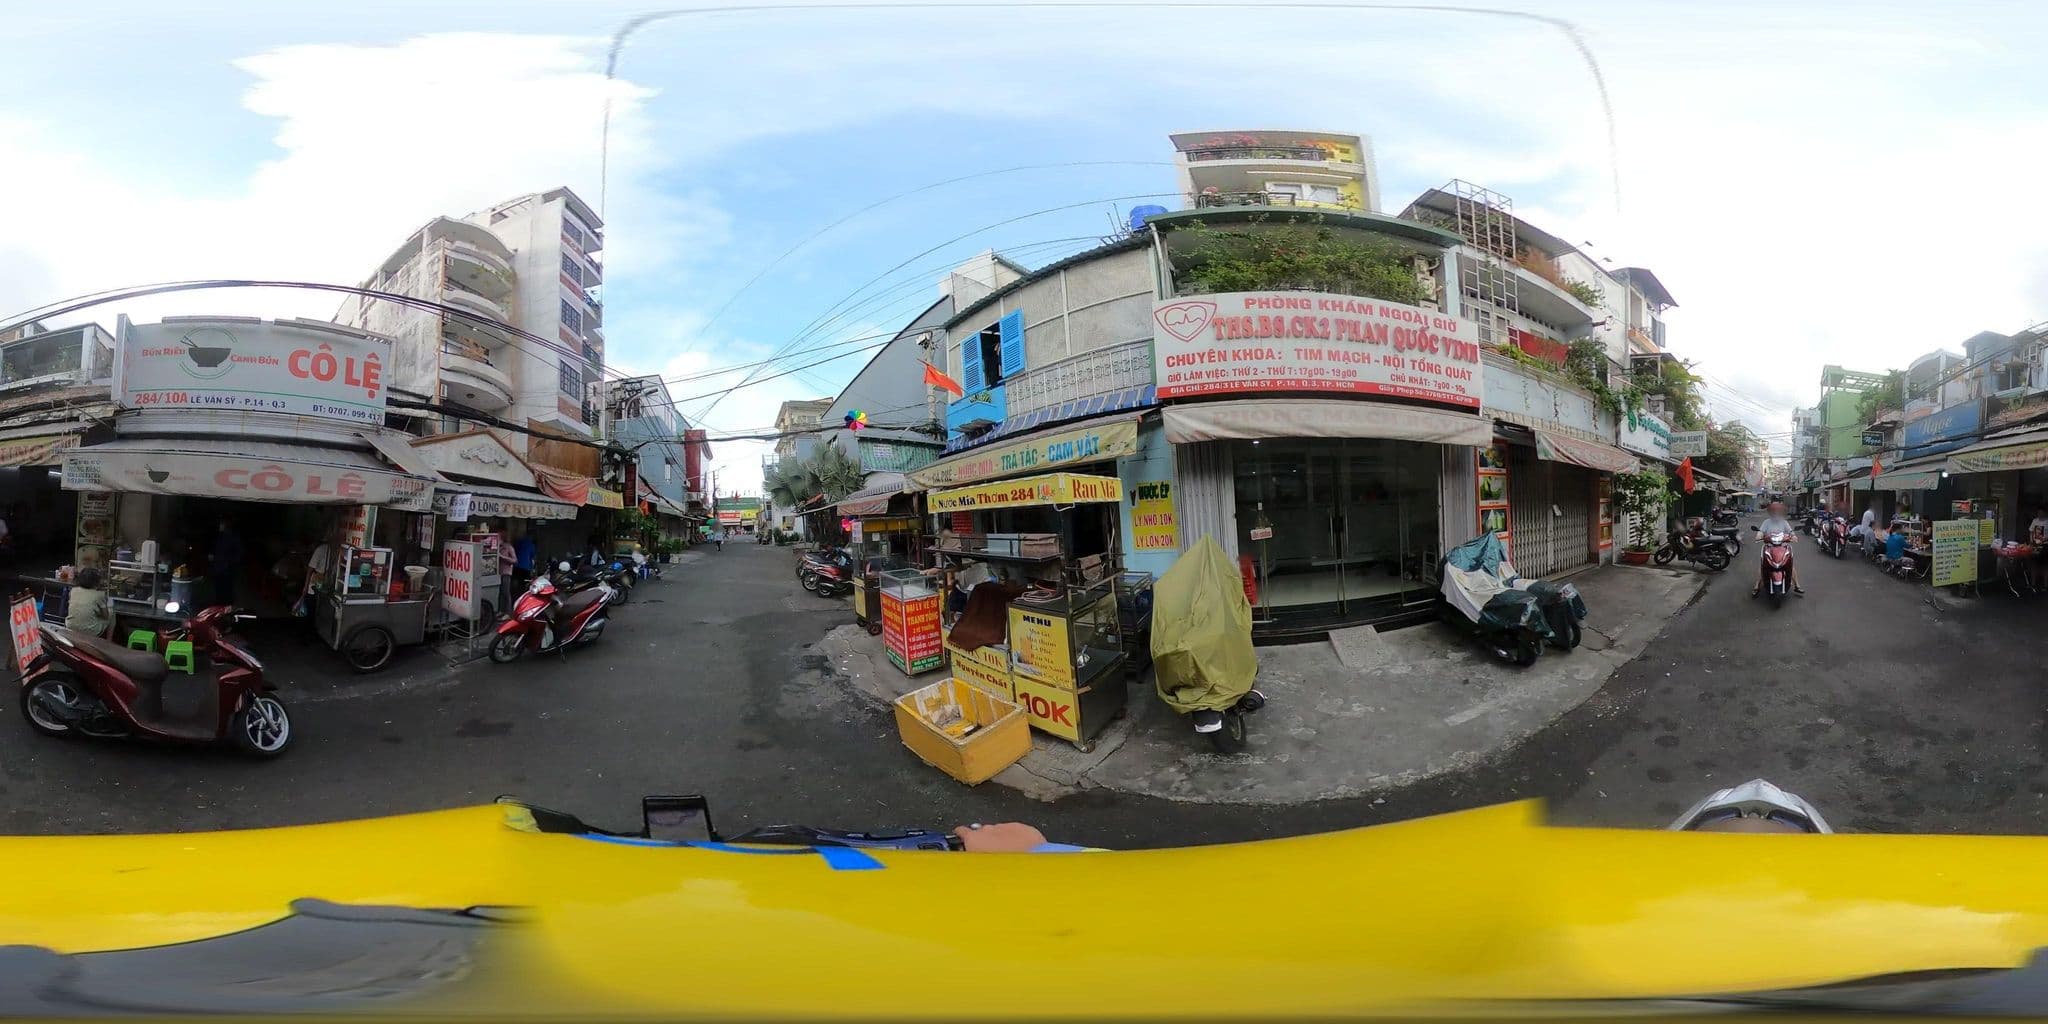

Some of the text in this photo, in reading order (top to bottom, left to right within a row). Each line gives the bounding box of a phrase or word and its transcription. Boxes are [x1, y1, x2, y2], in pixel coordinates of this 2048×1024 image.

[1244, 294, 1312, 311] PHÒNG
[1319, 299, 1373, 316] KHÁM
[1335, 318, 1389, 346] PHAN
[1393, 326, 1440, 354] QUỐC
[1440, 336, 1479, 364] VINH
[288, 342, 383, 399] CÔ LỆ
[1166, 348, 1228, 368] CHUYÊN
[1232, 347, 1283, 362] KHOA:
[1294, 348, 1323, 361] TIM
[1328, 350, 1371, 365] MẠCH
[1383, 355, 1405, 371] NỘI
[1410, 357, 1442, 376] TỔNG
[1445, 365, 1473, 382] QUÁT
[1253, 367, 1258, 376] 2
[134, 391, 188, 405] 284/10A
[1048, 441, 1074, 462] CAM
[214, 464, 294, 491] CÔ
[958, 495, 976, 507] Mía
[977, 490, 1009, 506] Thơm
[1010, 486, 1034, 502] 284
[1072, 478, 1097, 499] Rau
[1022, 615, 1052, 627] MENU
[1020, 692, 1073, 728] 10K
